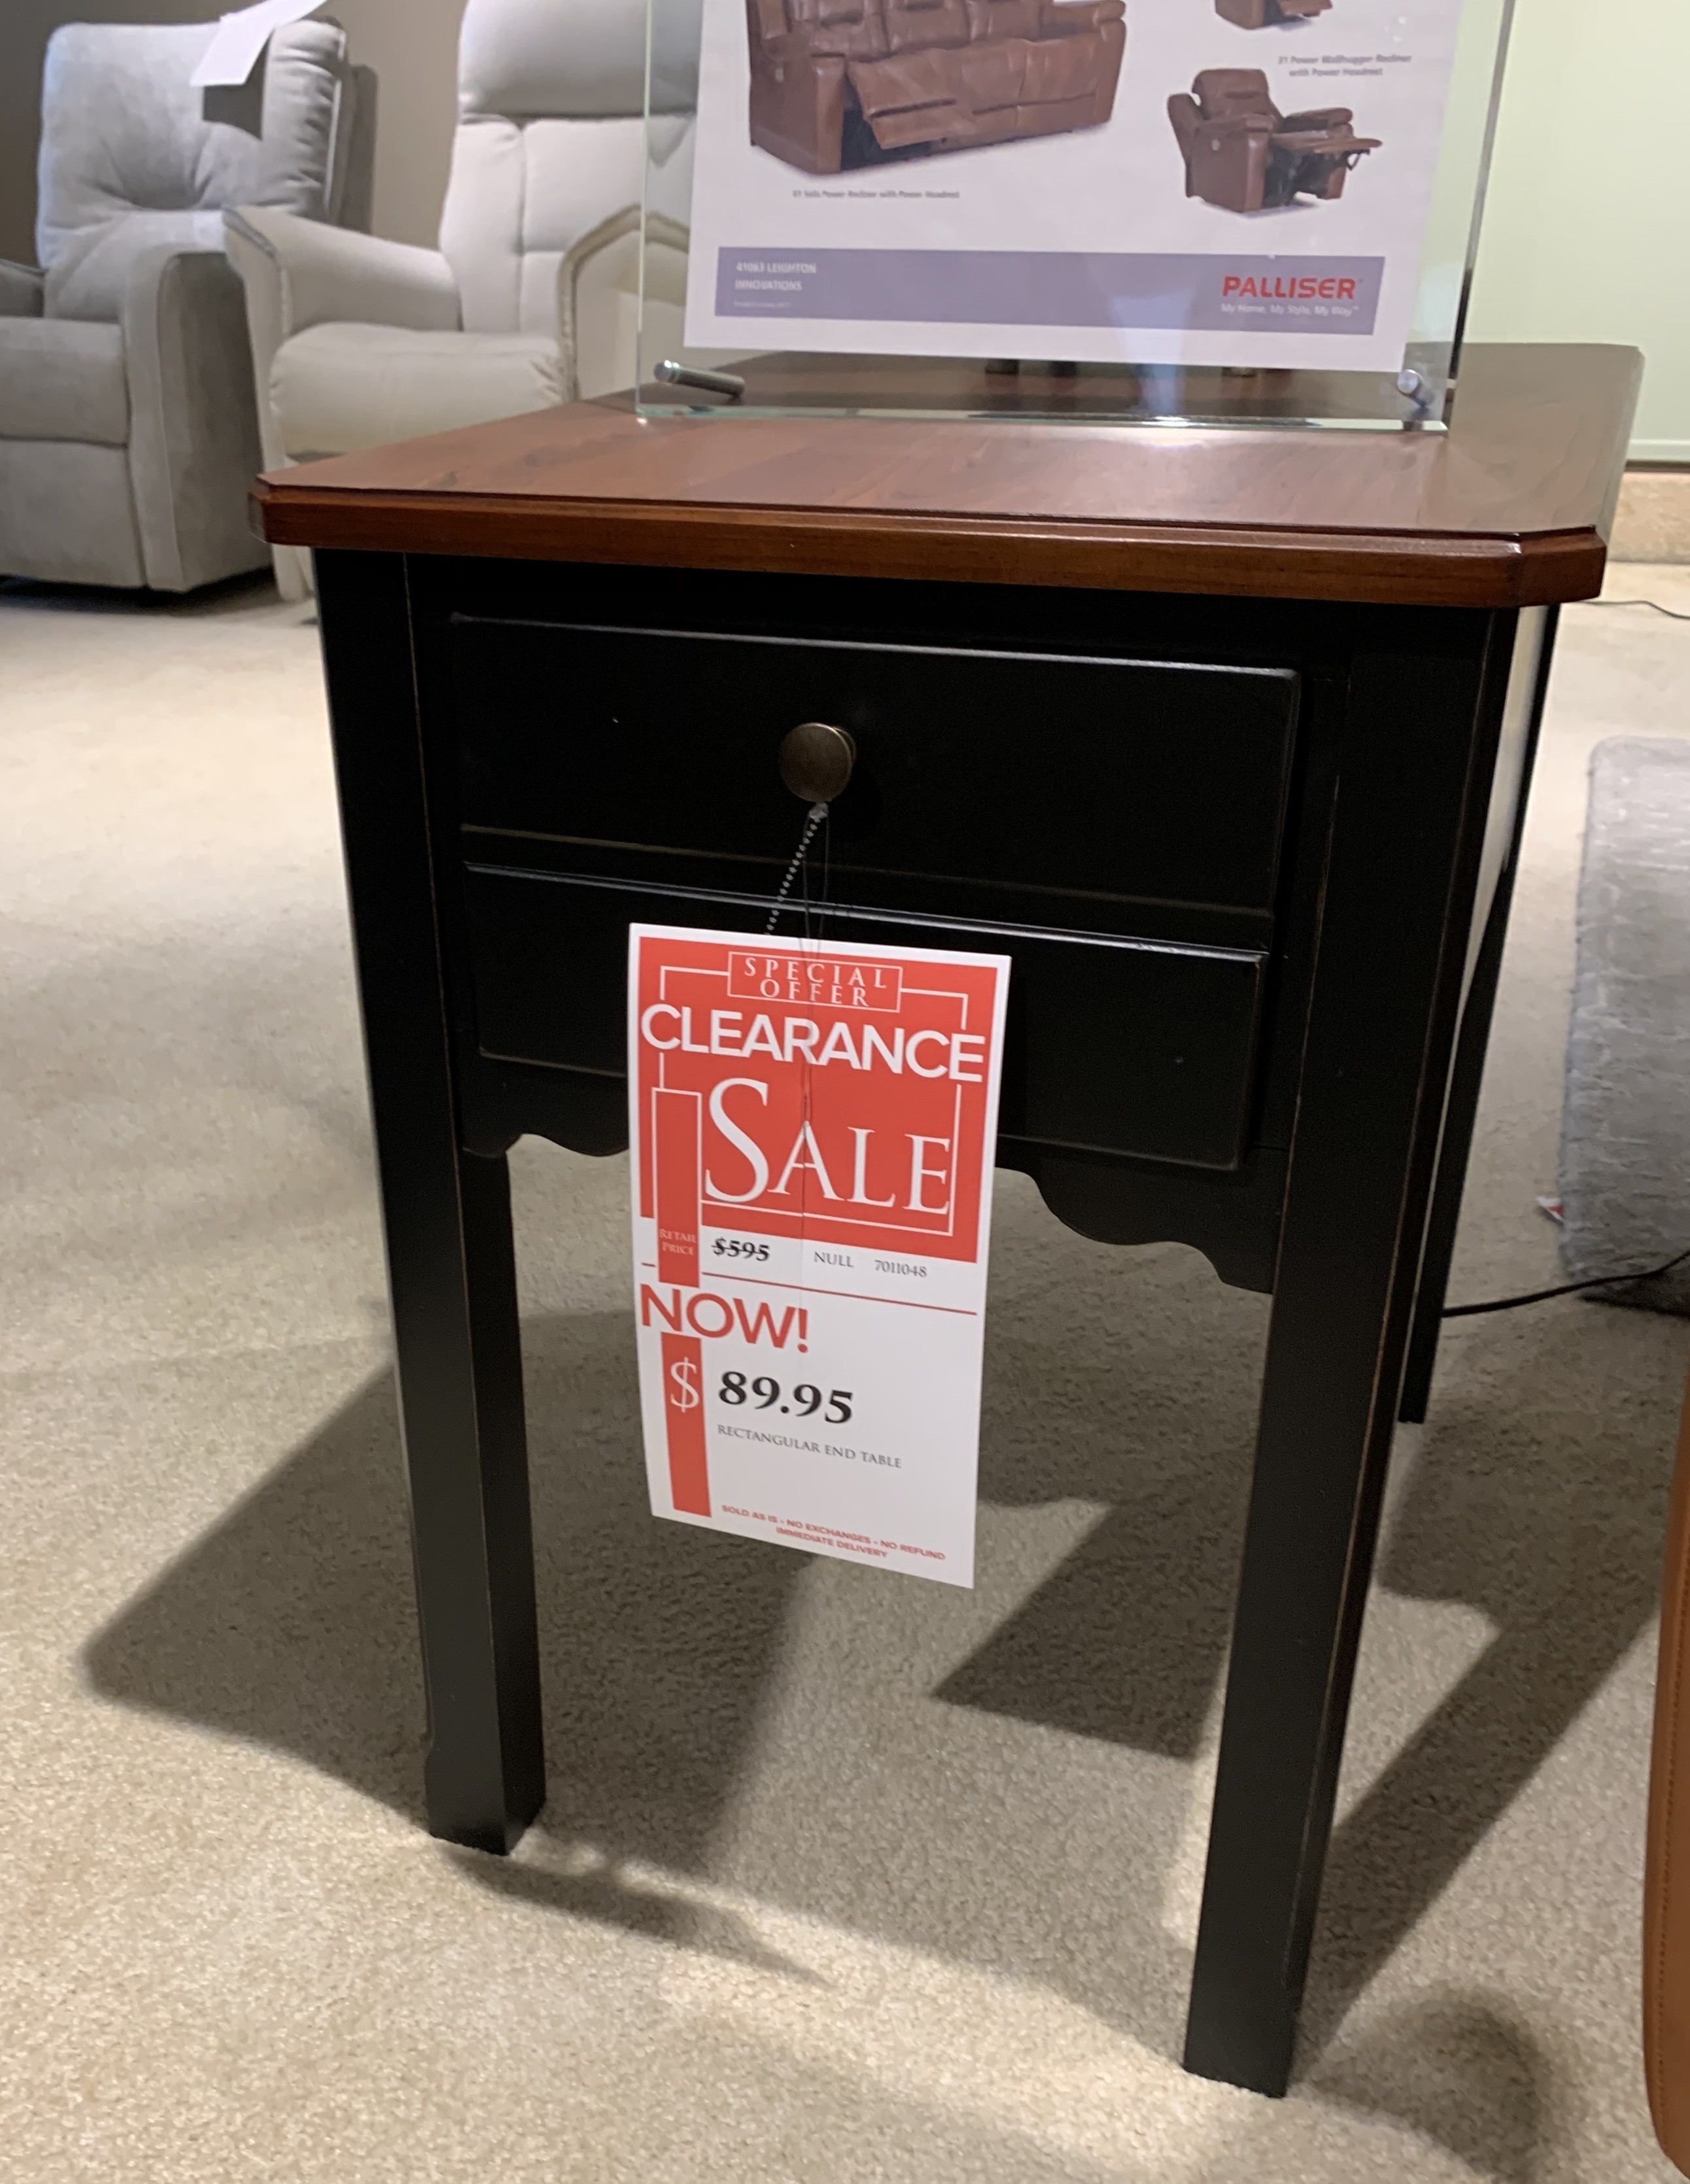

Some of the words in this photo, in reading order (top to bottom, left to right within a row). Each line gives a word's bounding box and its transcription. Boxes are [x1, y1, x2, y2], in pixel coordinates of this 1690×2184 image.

[767, 262, 816, 273] LEIGHTON
[735, 279, 802, 290] INNOVATIONS
[1222, 275, 1356, 300] PALLISER
[744, 957, 888, 989] SPECIAL
[759, 978, 871, 1007] OFFER
[641, 1003, 986, 1083] CLEARANCE
[704, 1077, 951, 1215] SALE
[658, 1228, 697, 1243] RETAIL
[661, 1241, 695, 1256] PRICE
[712, 1236, 770, 1262] $595
[814, 1251, 854, 1268] NULL
[874, 1259, 927, 1278] 7011048
[640, 1283, 808, 1353] NOW!
[718, 1371, 854, 1425] 89.95
[717, 1423, 820, 1453] RECTANGULAR
[824, 1445, 856, 1460] END
[860, 1451, 902, 1468] TABLE
[721, 1504, 750, 1517] SOLD
[751, 1512, 766, 1521] AS
[768, 1515, 778, 1523] IS
[787, 1518, 803, 1529] NO
[806, 1523, 871, 1545] EXCHANGES
[880, 1539, 898, 1550] NO
[900, 1544, 946, 1561] REFUND
[776, 1526, 834, 1547] IMMEDIATE
[836, 1540, 888, 1558] DELIVERY
